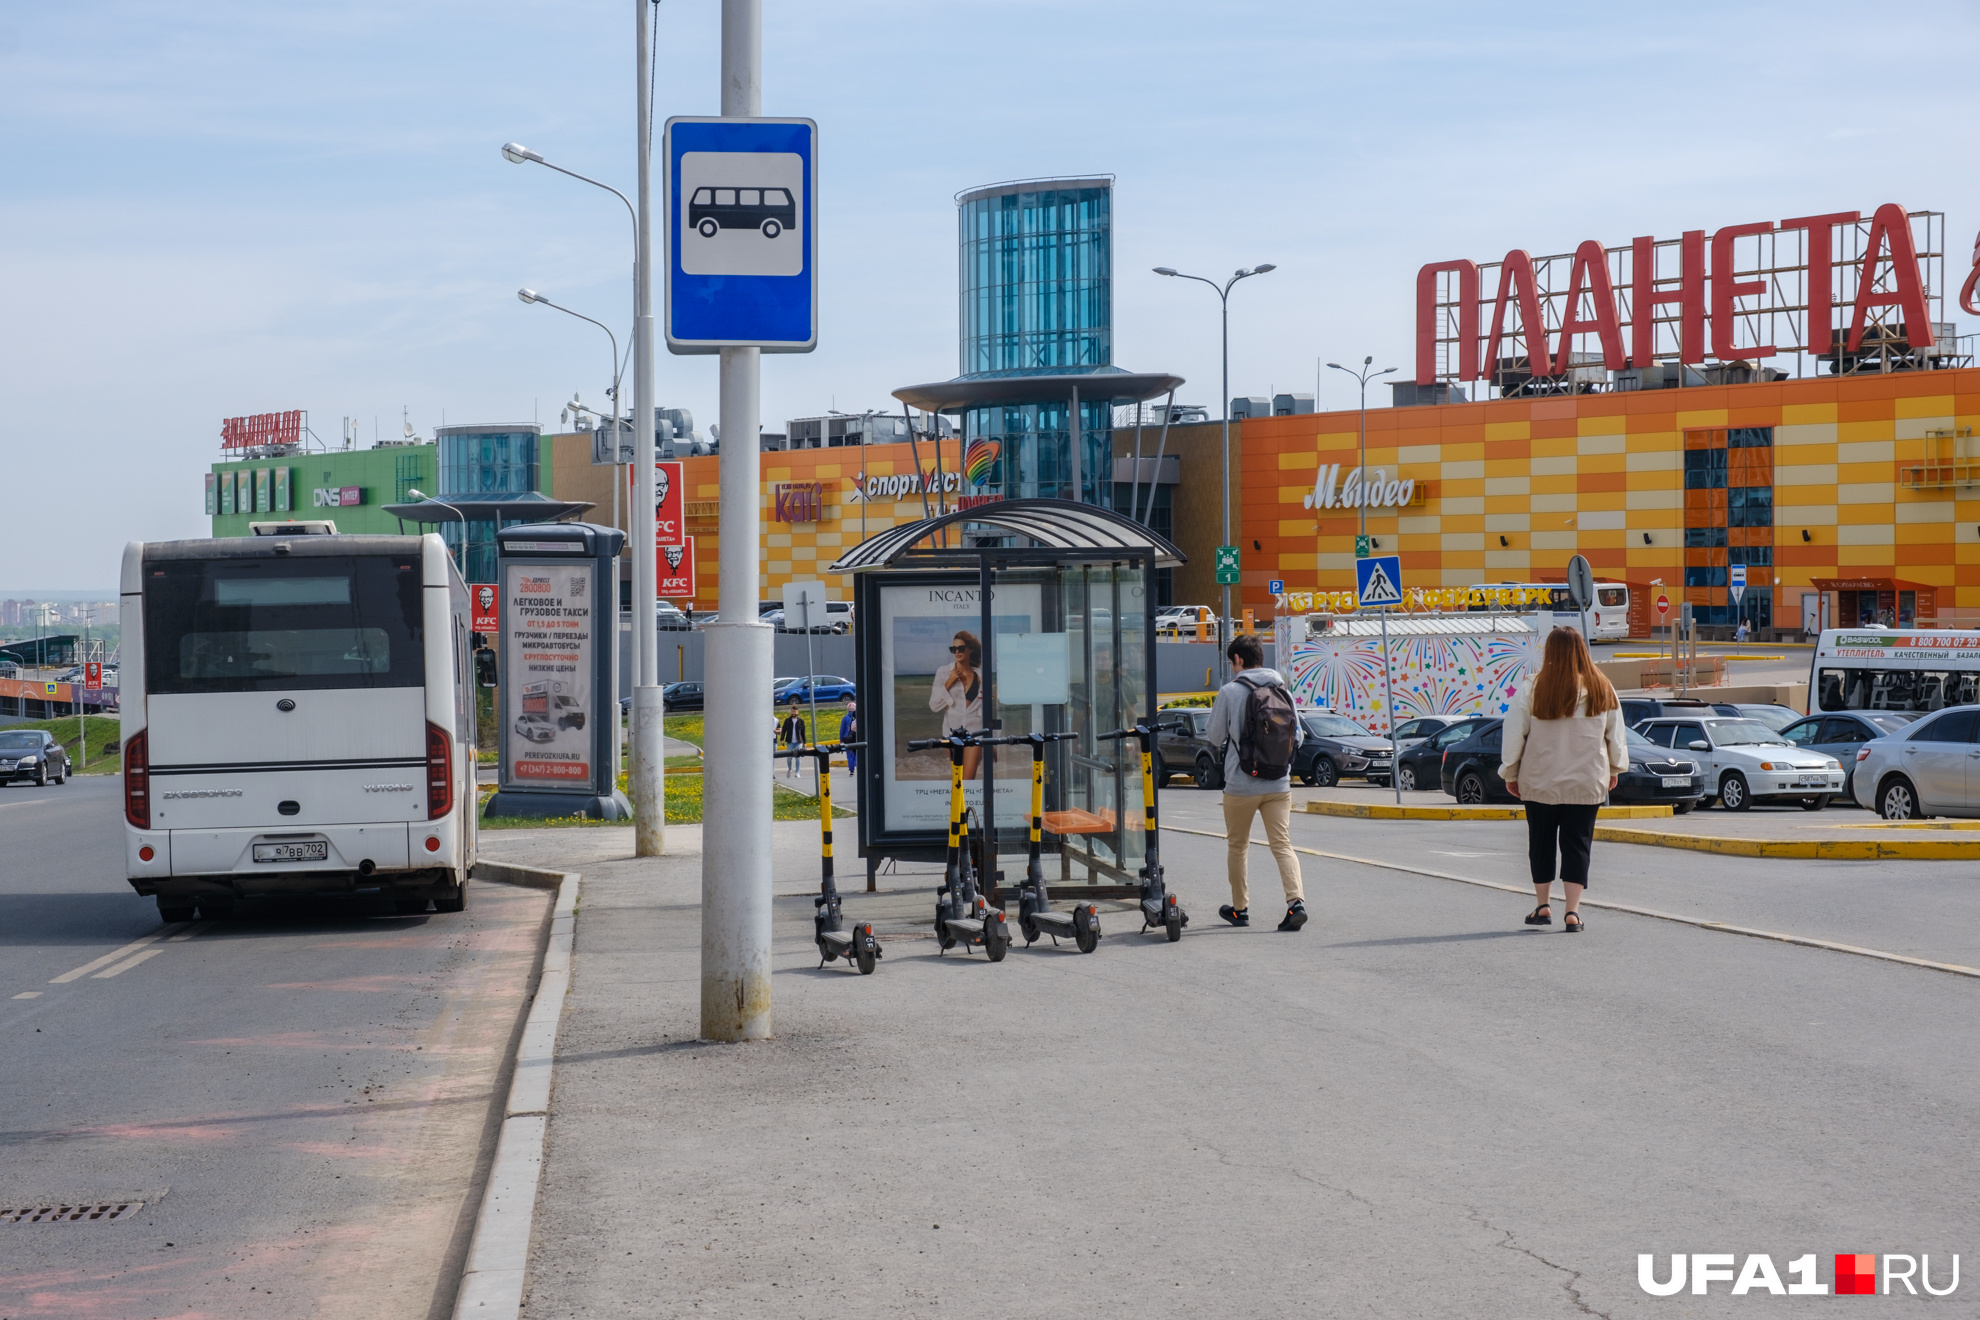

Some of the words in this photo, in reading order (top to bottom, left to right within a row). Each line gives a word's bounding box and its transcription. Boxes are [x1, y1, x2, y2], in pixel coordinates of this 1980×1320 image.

[1416, 203, 1935, 386] ПЛАНЕТА
[220, 409, 301, 449] ЭЛЬДОРАДО
[314, 488, 340, 506] DNS
[775, 482, 822, 522] kari
[656, 520, 674, 532] FC
[662, 578, 687, 587] KFC
[1226, 573, 1231, 582] 1
[520, 584, 551, 593] 2800800
[514, 598, 555, 606] ЛЕГКОВОЕ
[556, 598, 562, 606] И
[1423, 588, 1552, 608] ФЕЙЕРВЕРК
[520, 608, 561, 616] ГРУЗОВОЕ
[563, 608, 588, 616] ТАКСИ
[1910, 638, 1916, 646] 8
[1918, 638, 1934, 646] 800
[1936, 638, 1951, 646] 700
[1953, 638, 1964, 647] 07
[1966, 638, 1978, 647] 20
[1837, 649, 1885, 658] УТЕПЛИТЕЛЬ
[1894, 650, 1949, 659] КАЧЕСТВЕННЫЙ
[528, 764, 545, 773] (347)
[546, 765, 581, 774] 2-800-800
[362, 783, 414, 793] YUTONG
[305, 844, 323, 853] 702
